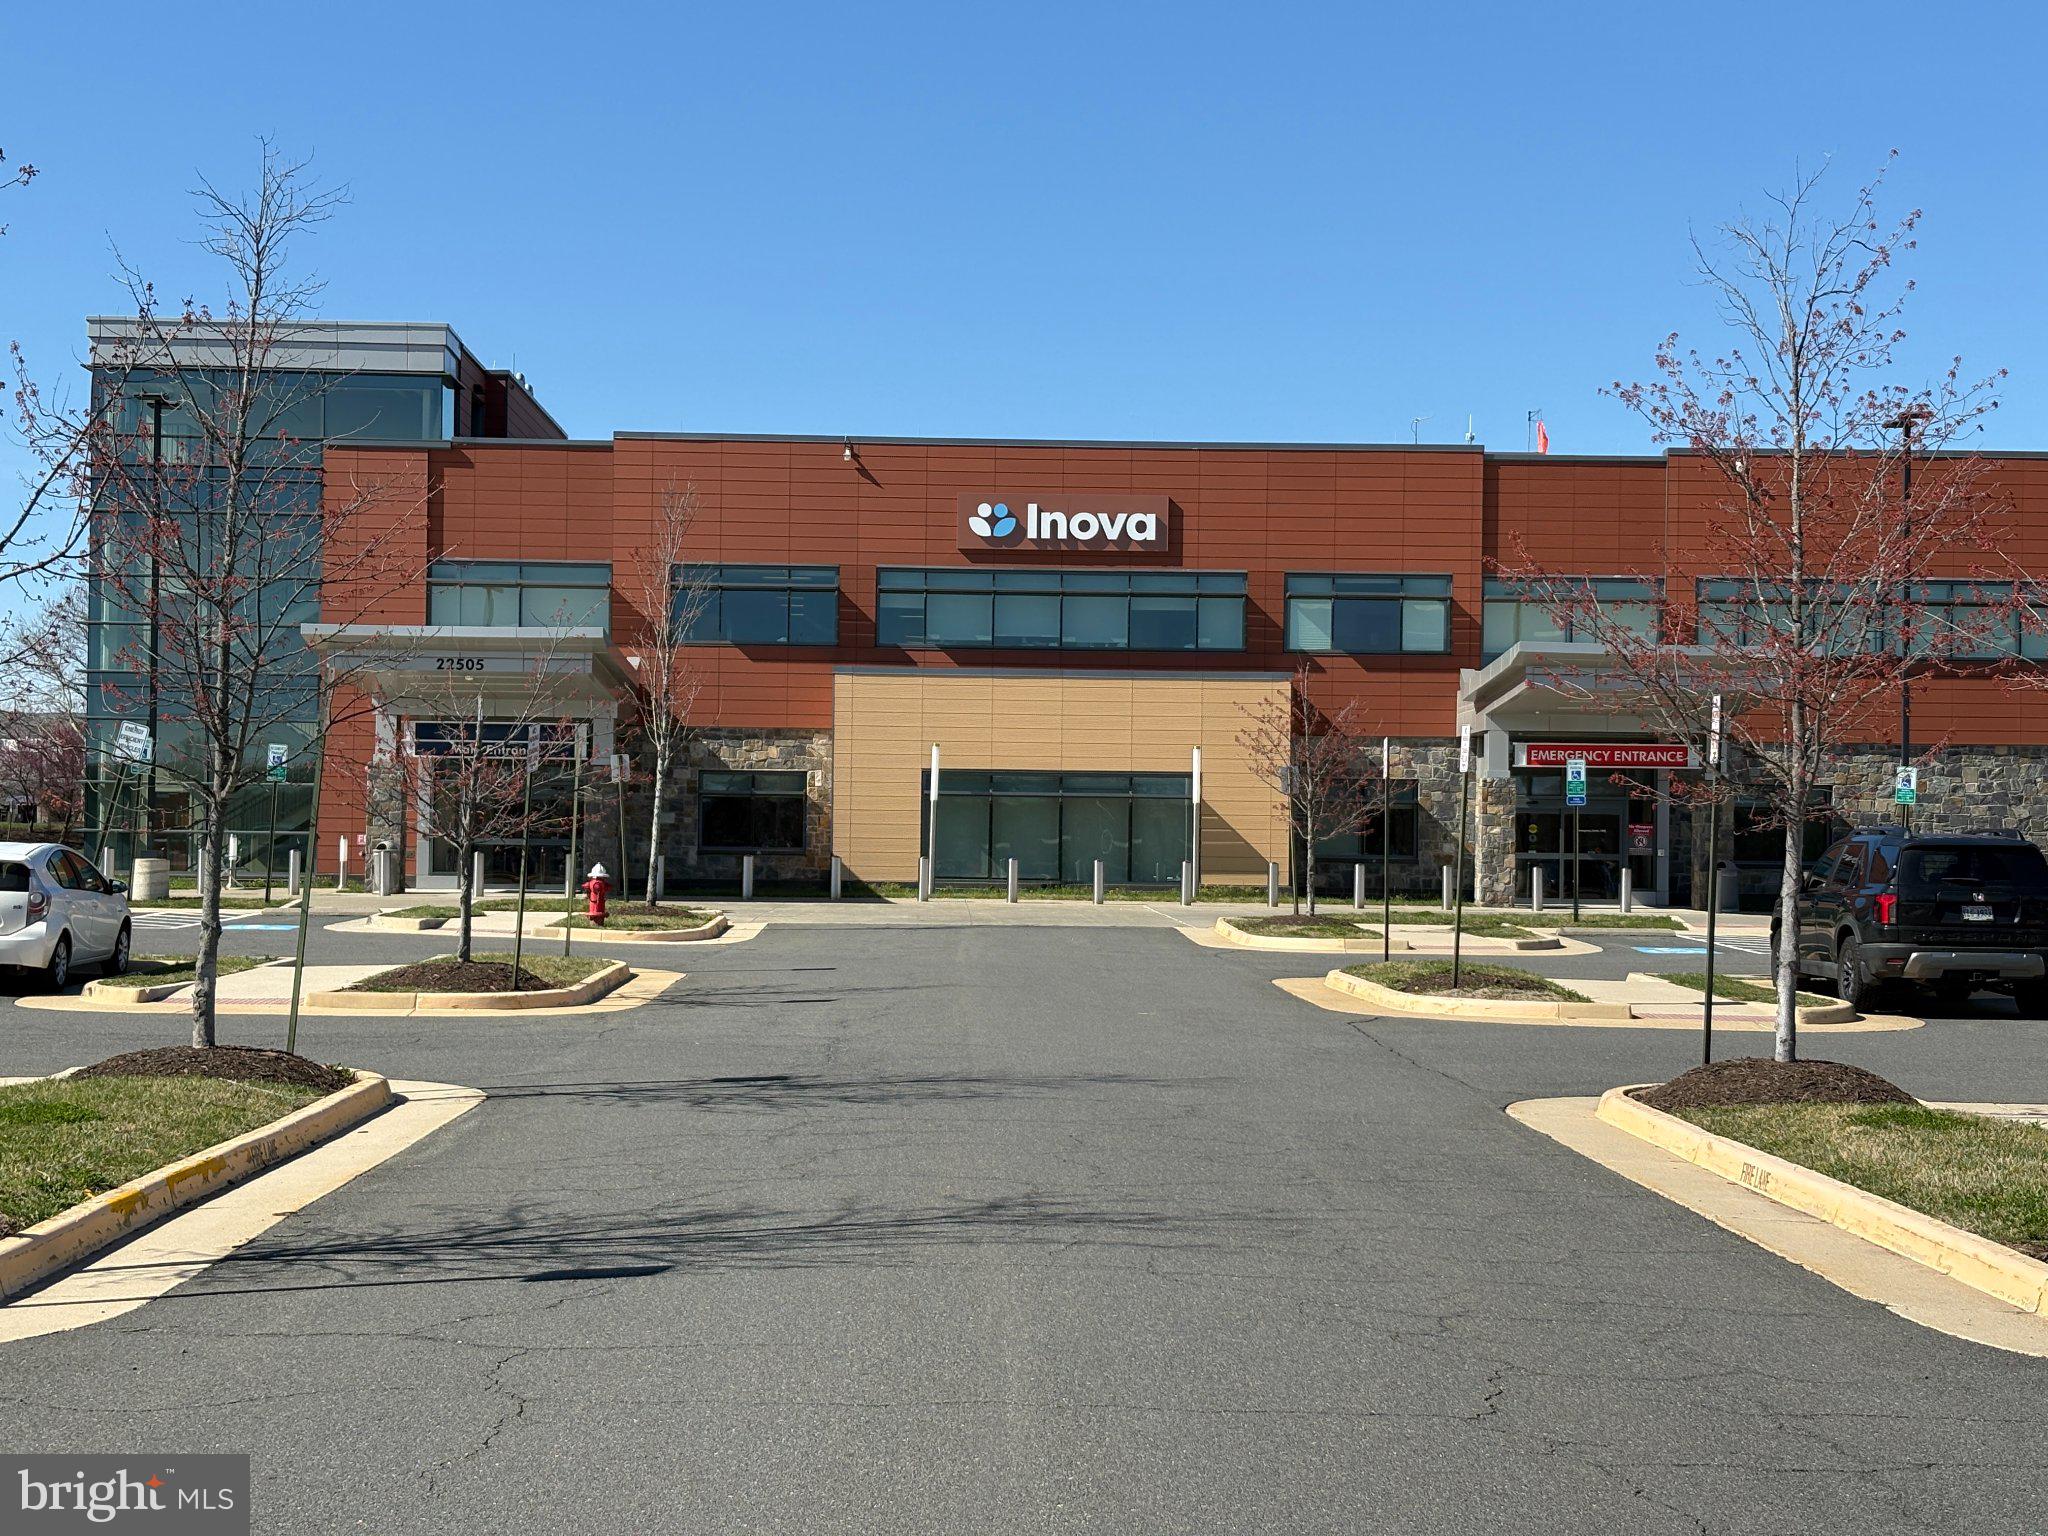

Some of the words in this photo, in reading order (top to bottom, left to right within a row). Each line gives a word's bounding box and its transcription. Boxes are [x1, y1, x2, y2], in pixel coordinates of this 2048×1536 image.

[1027, 503, 1156, 541] Inova
[436, 658, 485, 671] 22505
[1530, 749, 1611, 762] EMERGENCY
[1614, 751, 1685, 763] ENTRANCE
